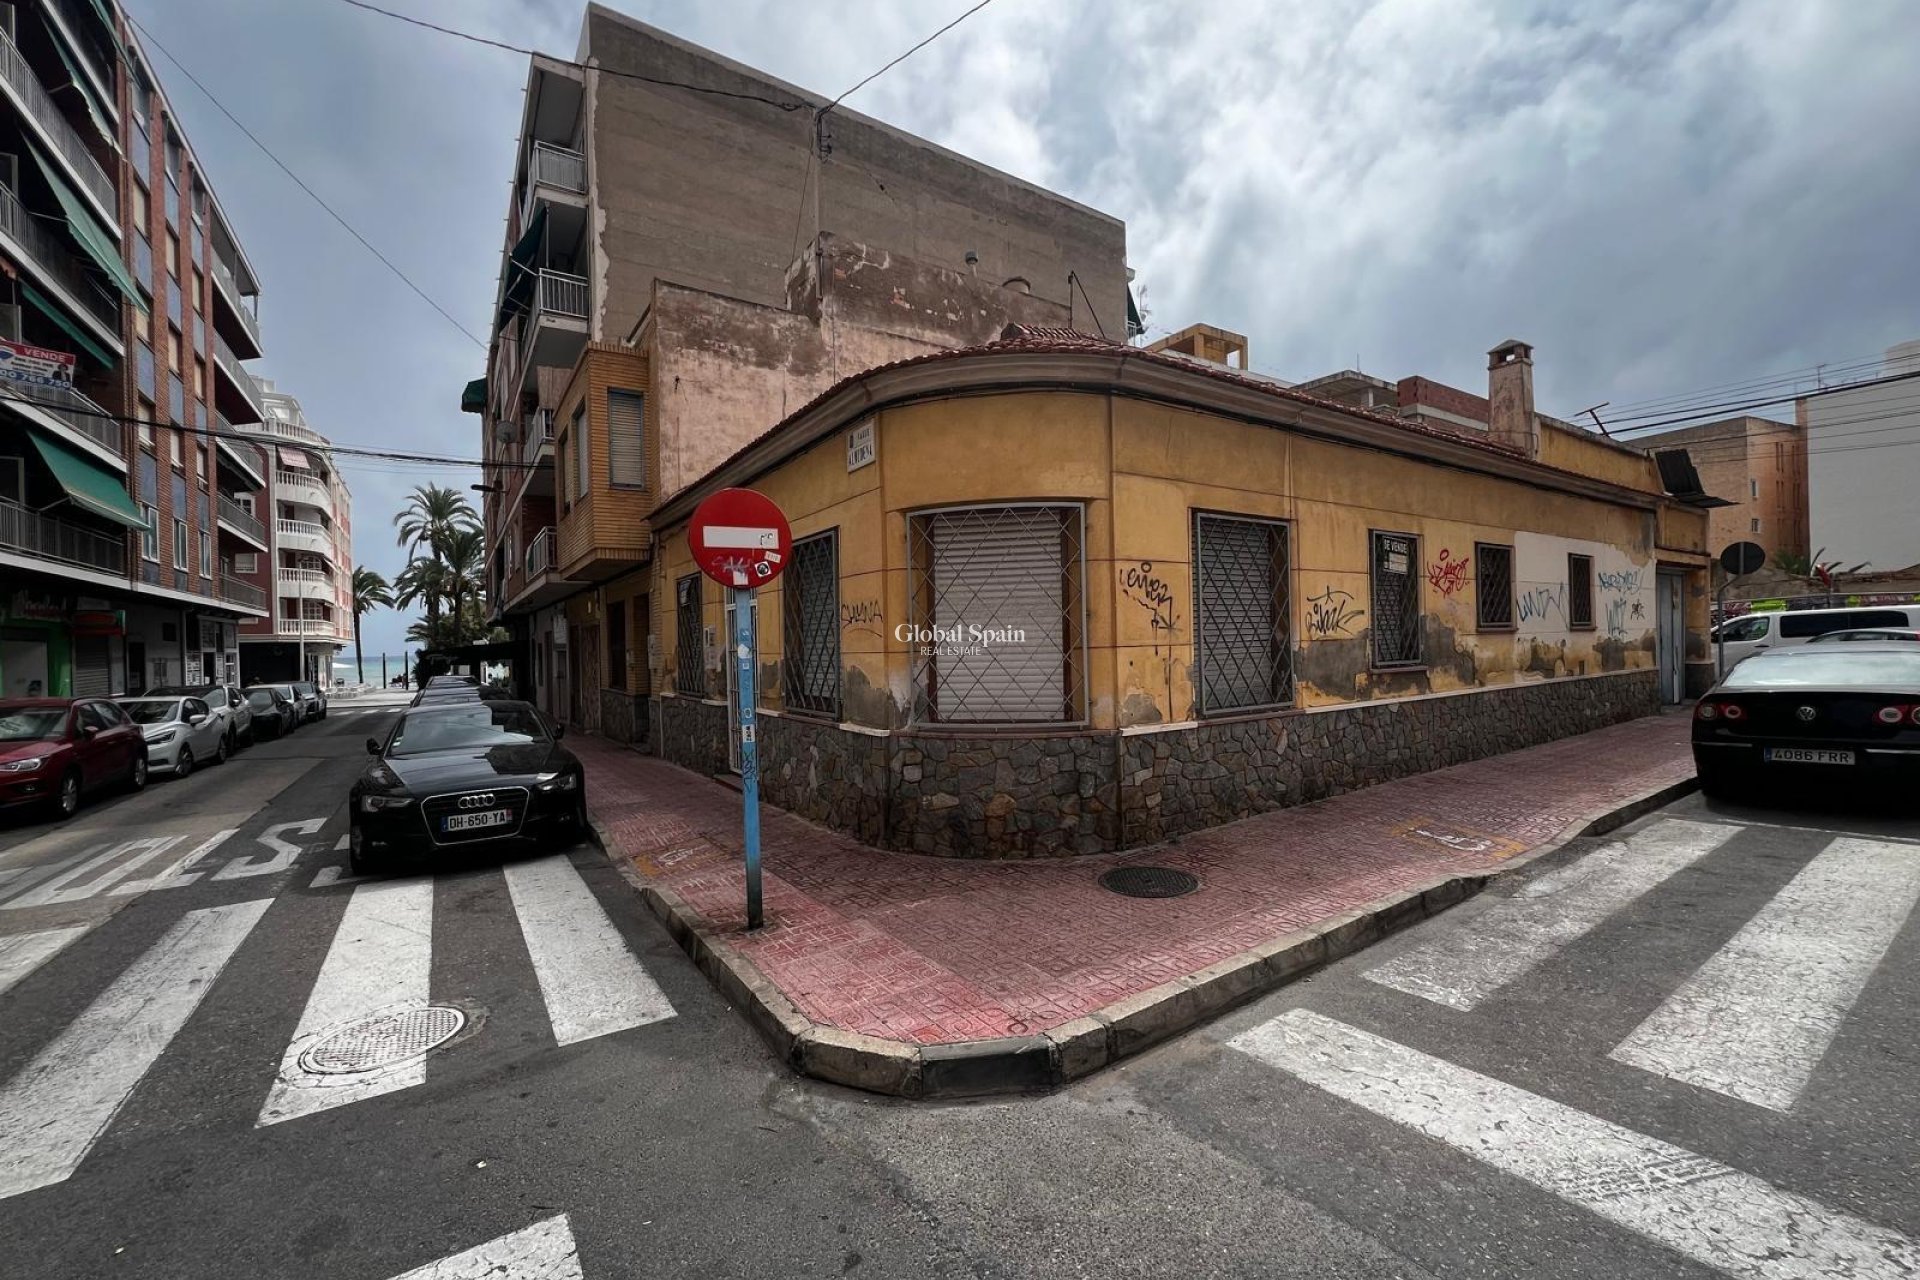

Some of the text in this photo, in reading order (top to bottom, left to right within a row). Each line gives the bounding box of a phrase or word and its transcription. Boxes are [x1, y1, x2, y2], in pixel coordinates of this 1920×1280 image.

[24, 347, 66, 363] VENDE
[1775, 749, 1849, 764] 4086 FRR
